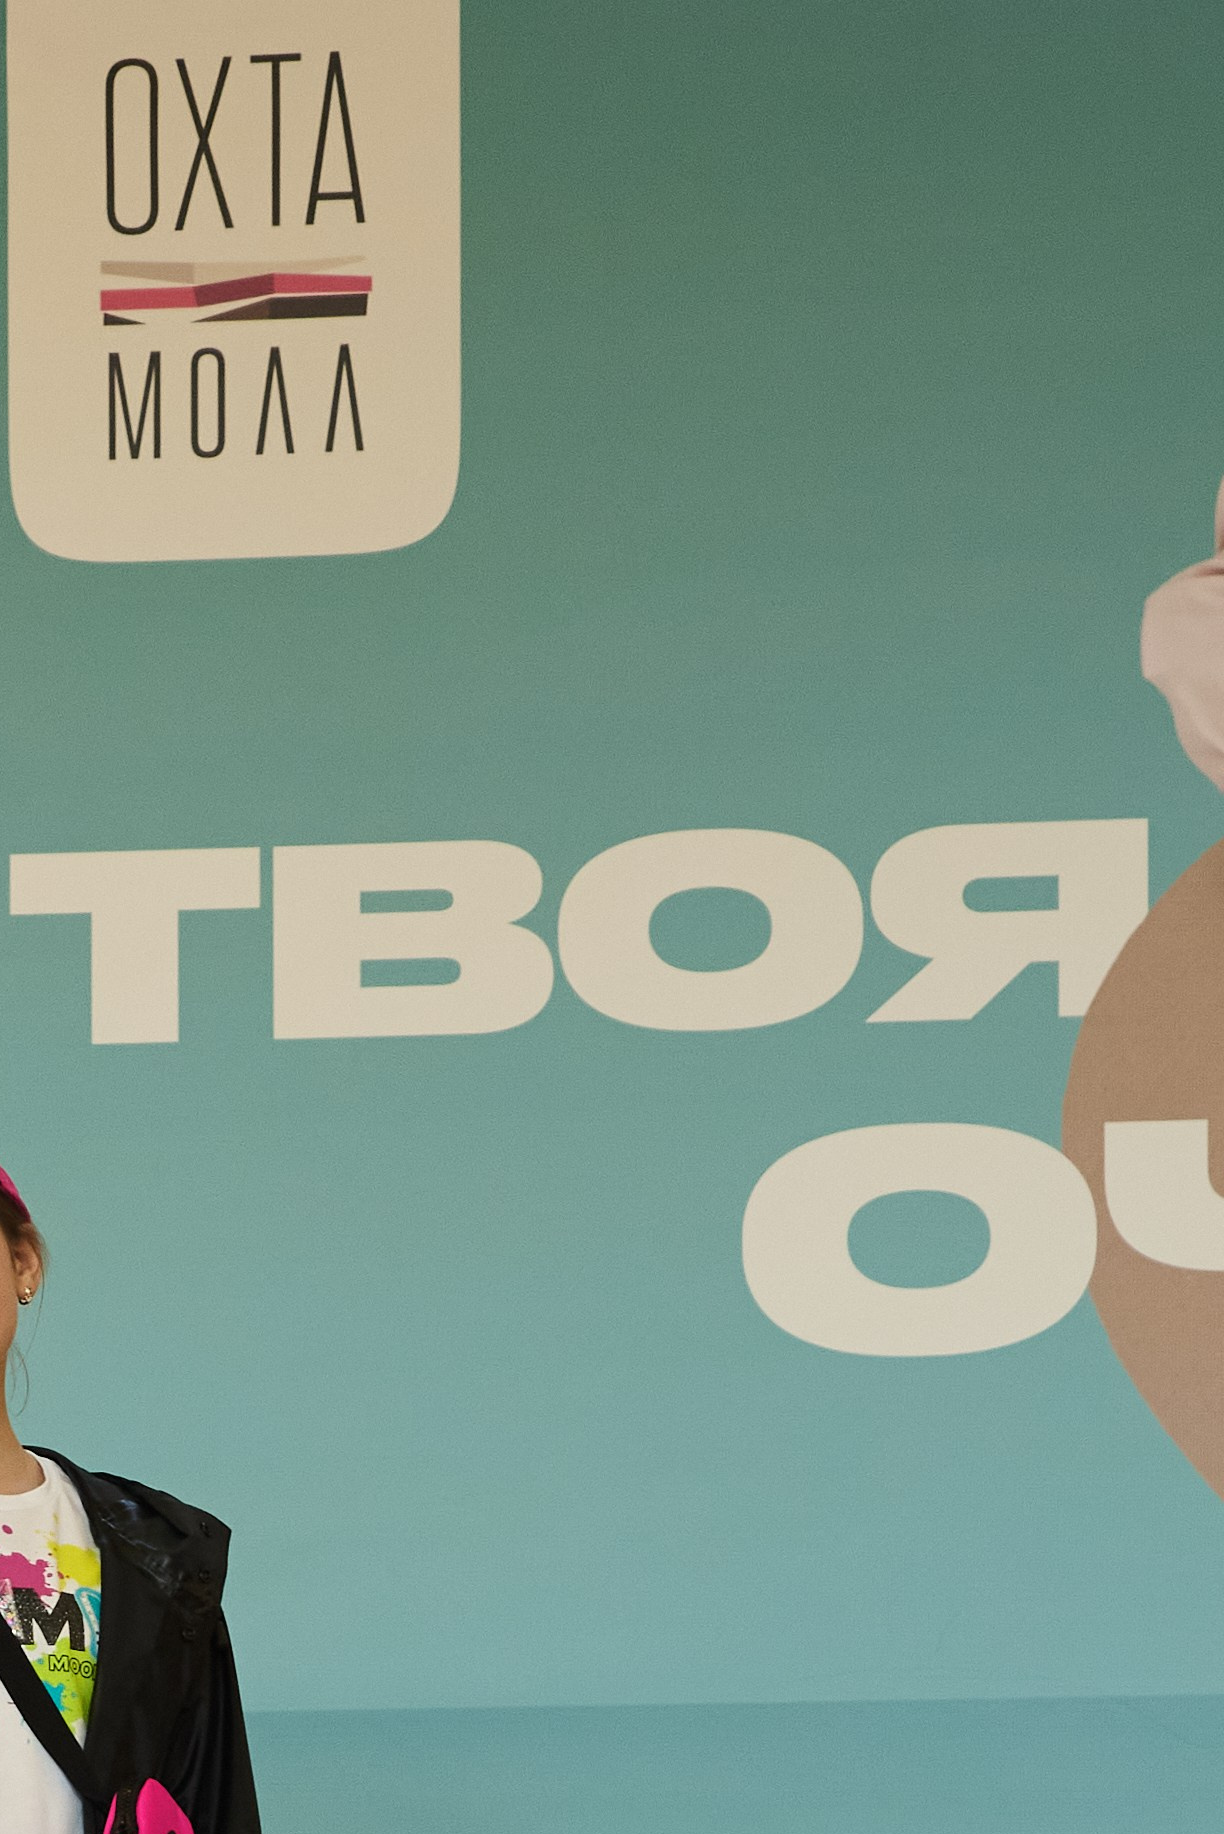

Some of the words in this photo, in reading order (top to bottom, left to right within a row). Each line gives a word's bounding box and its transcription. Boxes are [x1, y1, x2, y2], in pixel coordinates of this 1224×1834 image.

[103, 50, 367, 236] ОХТА
[107, 344, 366, 462] МОЛЛ
[8, 817, 1150, 1045] ТВОЯ
[48, 1653, 97, 1681] MOO
